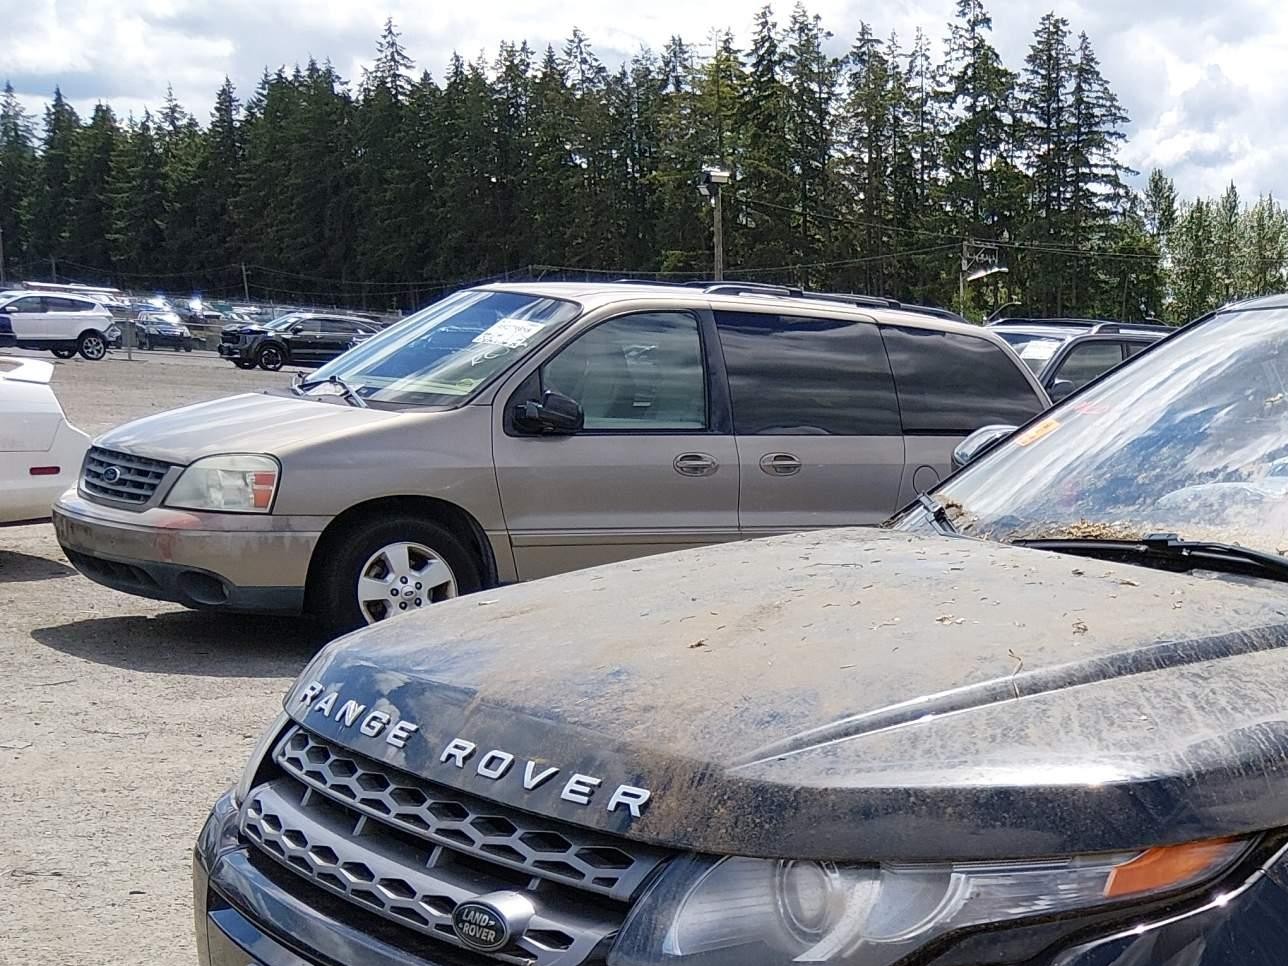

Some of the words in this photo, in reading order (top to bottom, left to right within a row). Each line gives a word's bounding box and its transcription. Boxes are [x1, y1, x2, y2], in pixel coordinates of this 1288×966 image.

[300, 680, 418, 749] RANGE
[439, 737, 652, 818] ROVER
[462, 908, 490, 927] LAND
[462, 923, 496, 943] ROVER
